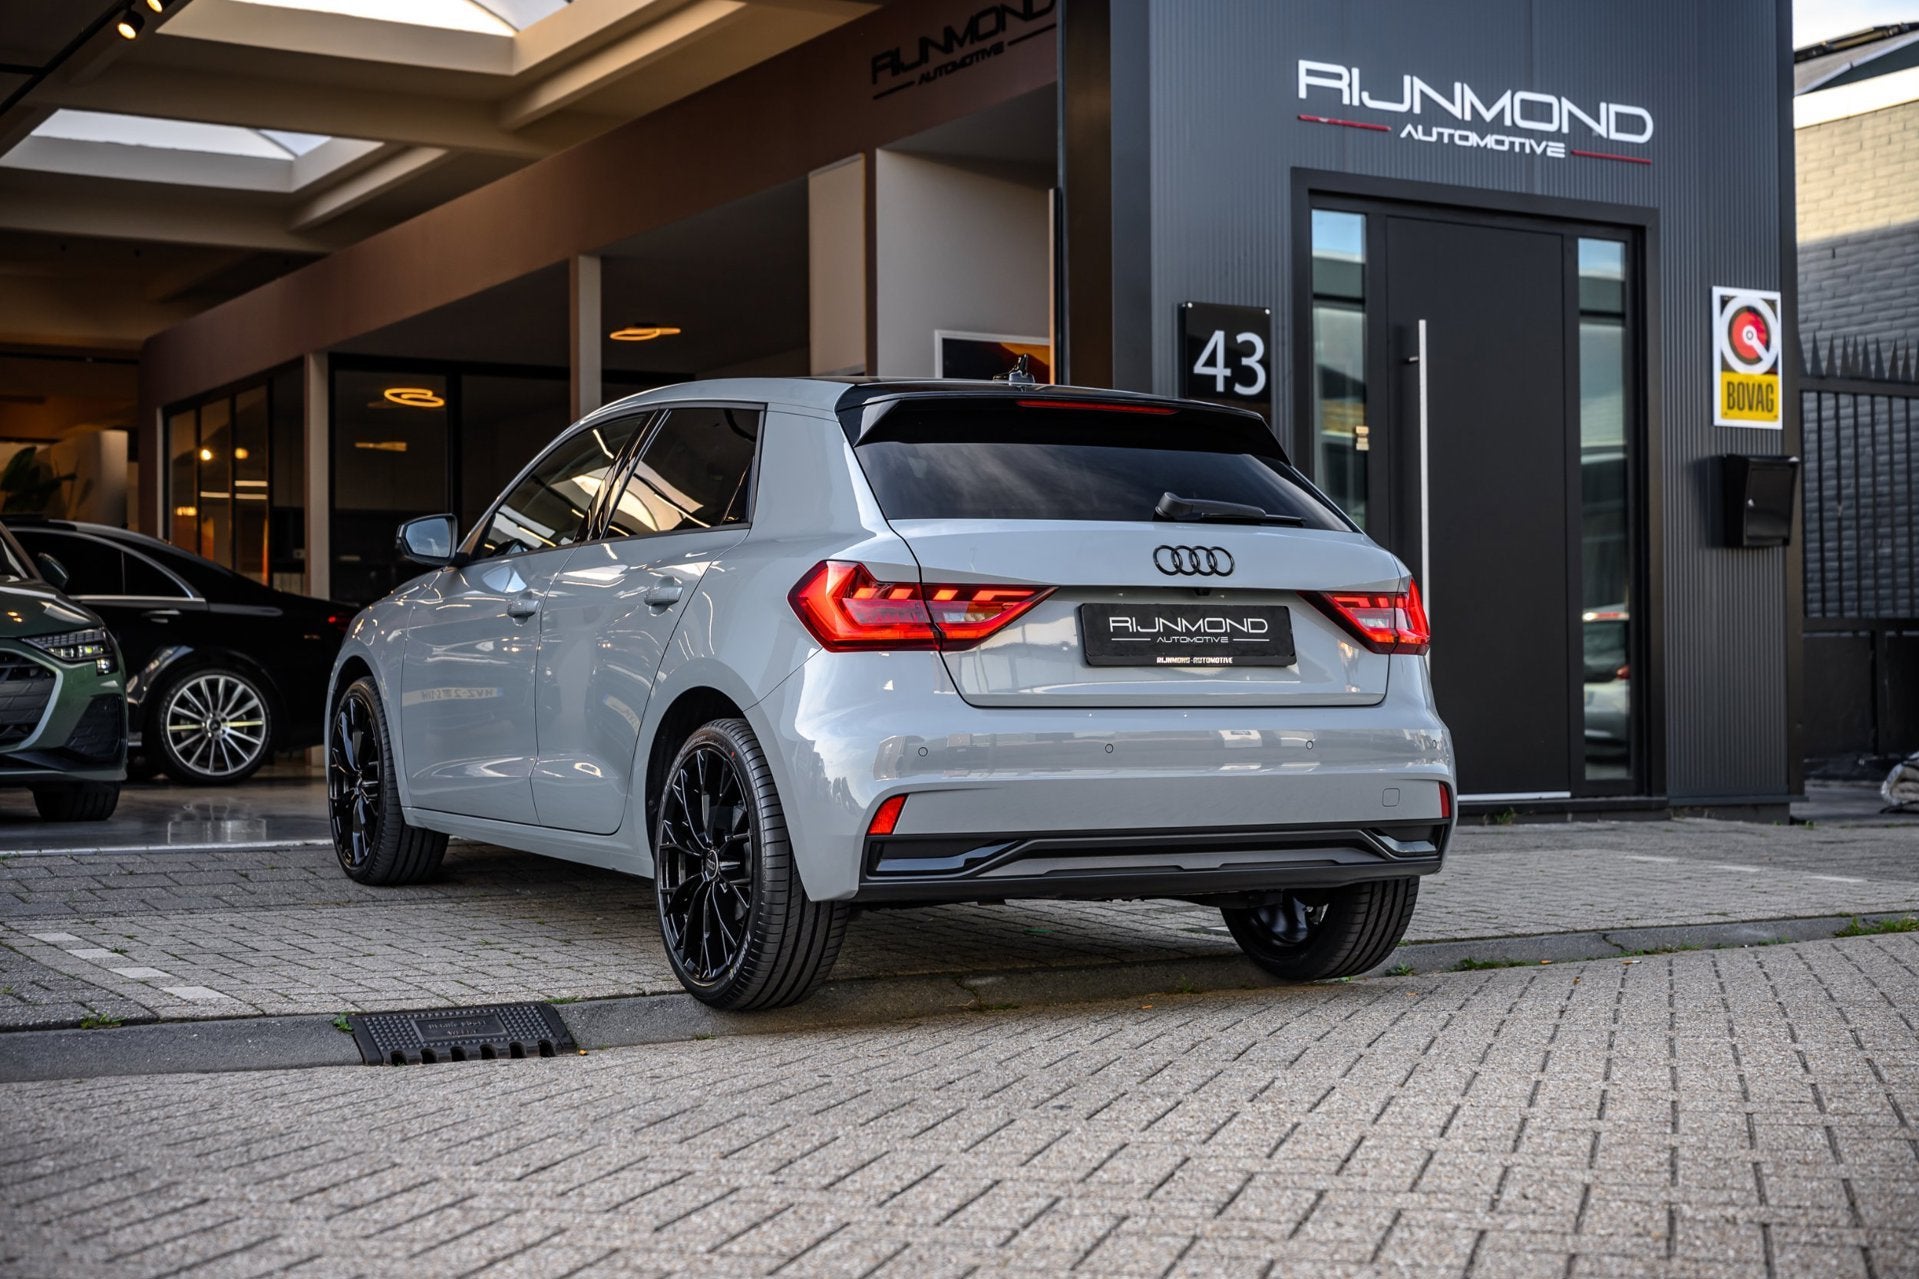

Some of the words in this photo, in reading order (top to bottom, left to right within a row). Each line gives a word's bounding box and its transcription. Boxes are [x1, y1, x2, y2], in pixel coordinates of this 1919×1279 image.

[917, 42, 1004, 85] AUTOMOTIVE
[1298, 60, 1654, 144] RIJNMOND
[1400, 123, 1566, 158] AUTOMOTIVE
[1193, 330, 1266, 395] 43
[1727, 381, 1774, 412] BOVAG
[1109, 617, 1268, 633] RIJNMOND
